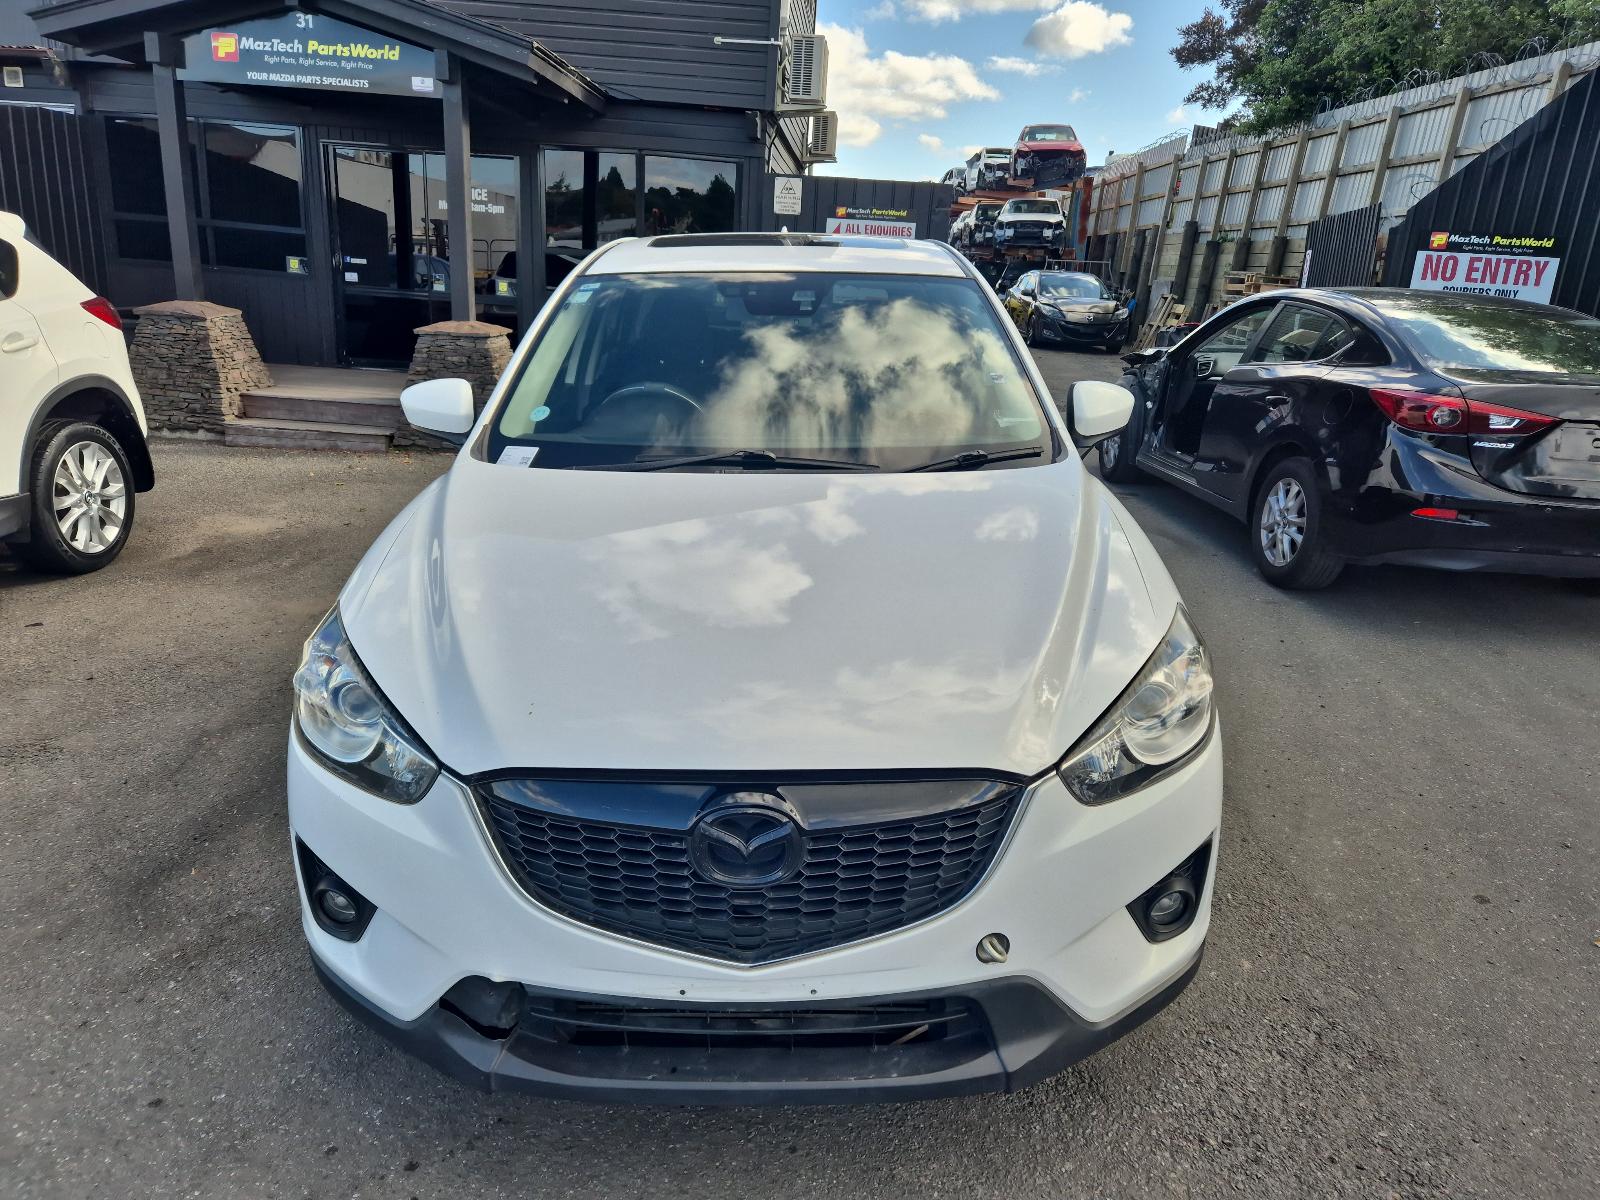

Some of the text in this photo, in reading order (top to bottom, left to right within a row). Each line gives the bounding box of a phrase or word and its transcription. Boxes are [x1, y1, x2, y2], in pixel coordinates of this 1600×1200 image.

[296, 13, 313, 29] 31
[240, 37, 400, 60] MazTech PartsWorld
[264, 55, 280, 64] Right
[299, 58, 315, 67] Right
[341, 60, 357, 70] Right
[358, 61, 373, 70] Price
[247, 71, 369, 88] YOUR MAZDA PARTS SPECIALISTS
[471, 188, 488, 201] ICE
[846, 207, 871, 215] MazTech
[871, 208, 908, 217] PartsWorld
[845, 223, 913, 237] ALL ENQUIRIES
[1449, 234, 1555, 248] MazTech PartsWorld
[1421, 254, 1550, 288] NO ENTRY
